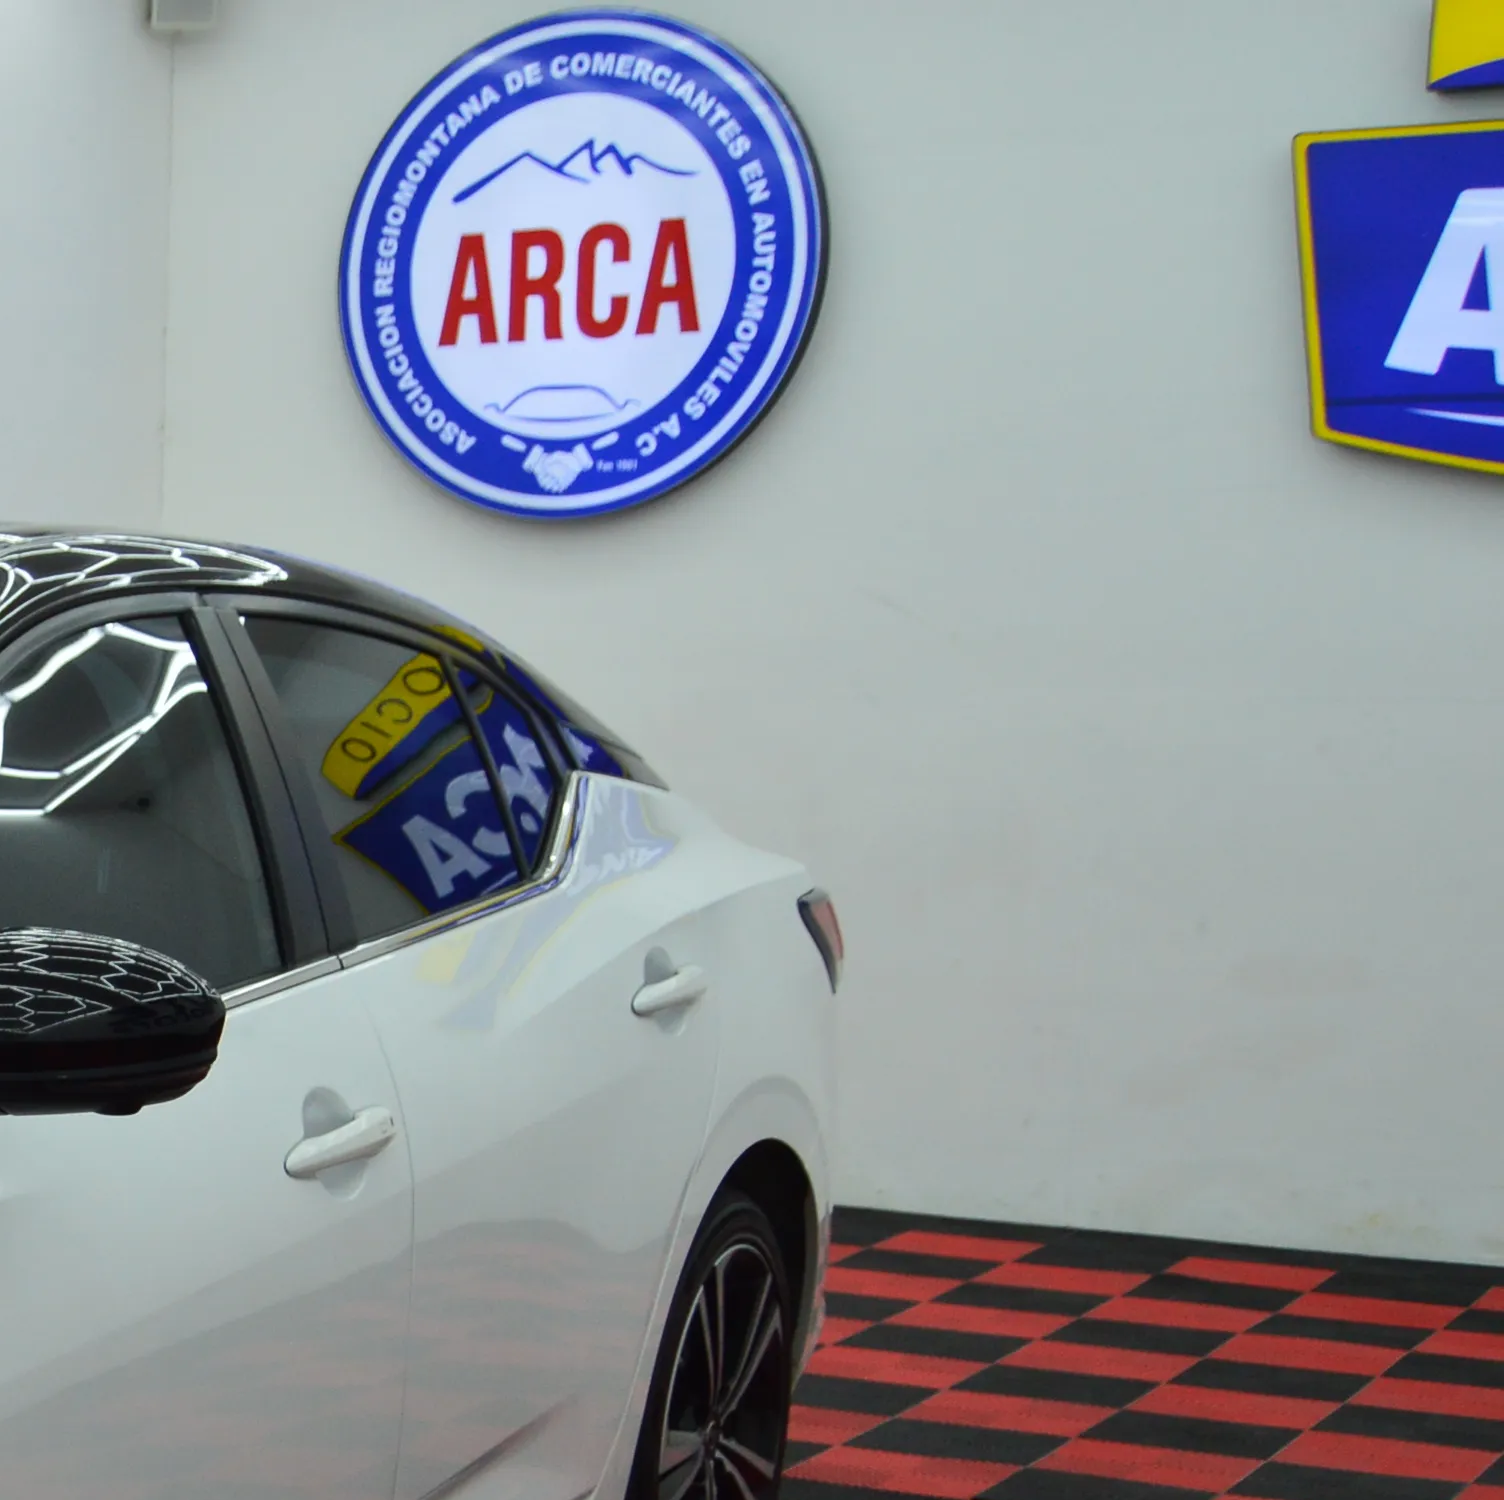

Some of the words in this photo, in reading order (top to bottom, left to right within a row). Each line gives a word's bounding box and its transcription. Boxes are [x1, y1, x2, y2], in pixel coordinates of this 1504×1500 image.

[503, 61, 544, 96] DE
[549, 51, 752, 161] COMERCIANTES
[372, 84, 501, 298] REGIOMONTANA
[738, 158, 772, 206] EN
[437, 216, 702, 348] ARCA
[683, 211, 777, 421] AUTOMOVILES
[374, 303, 478, 455] ASOCIACION
